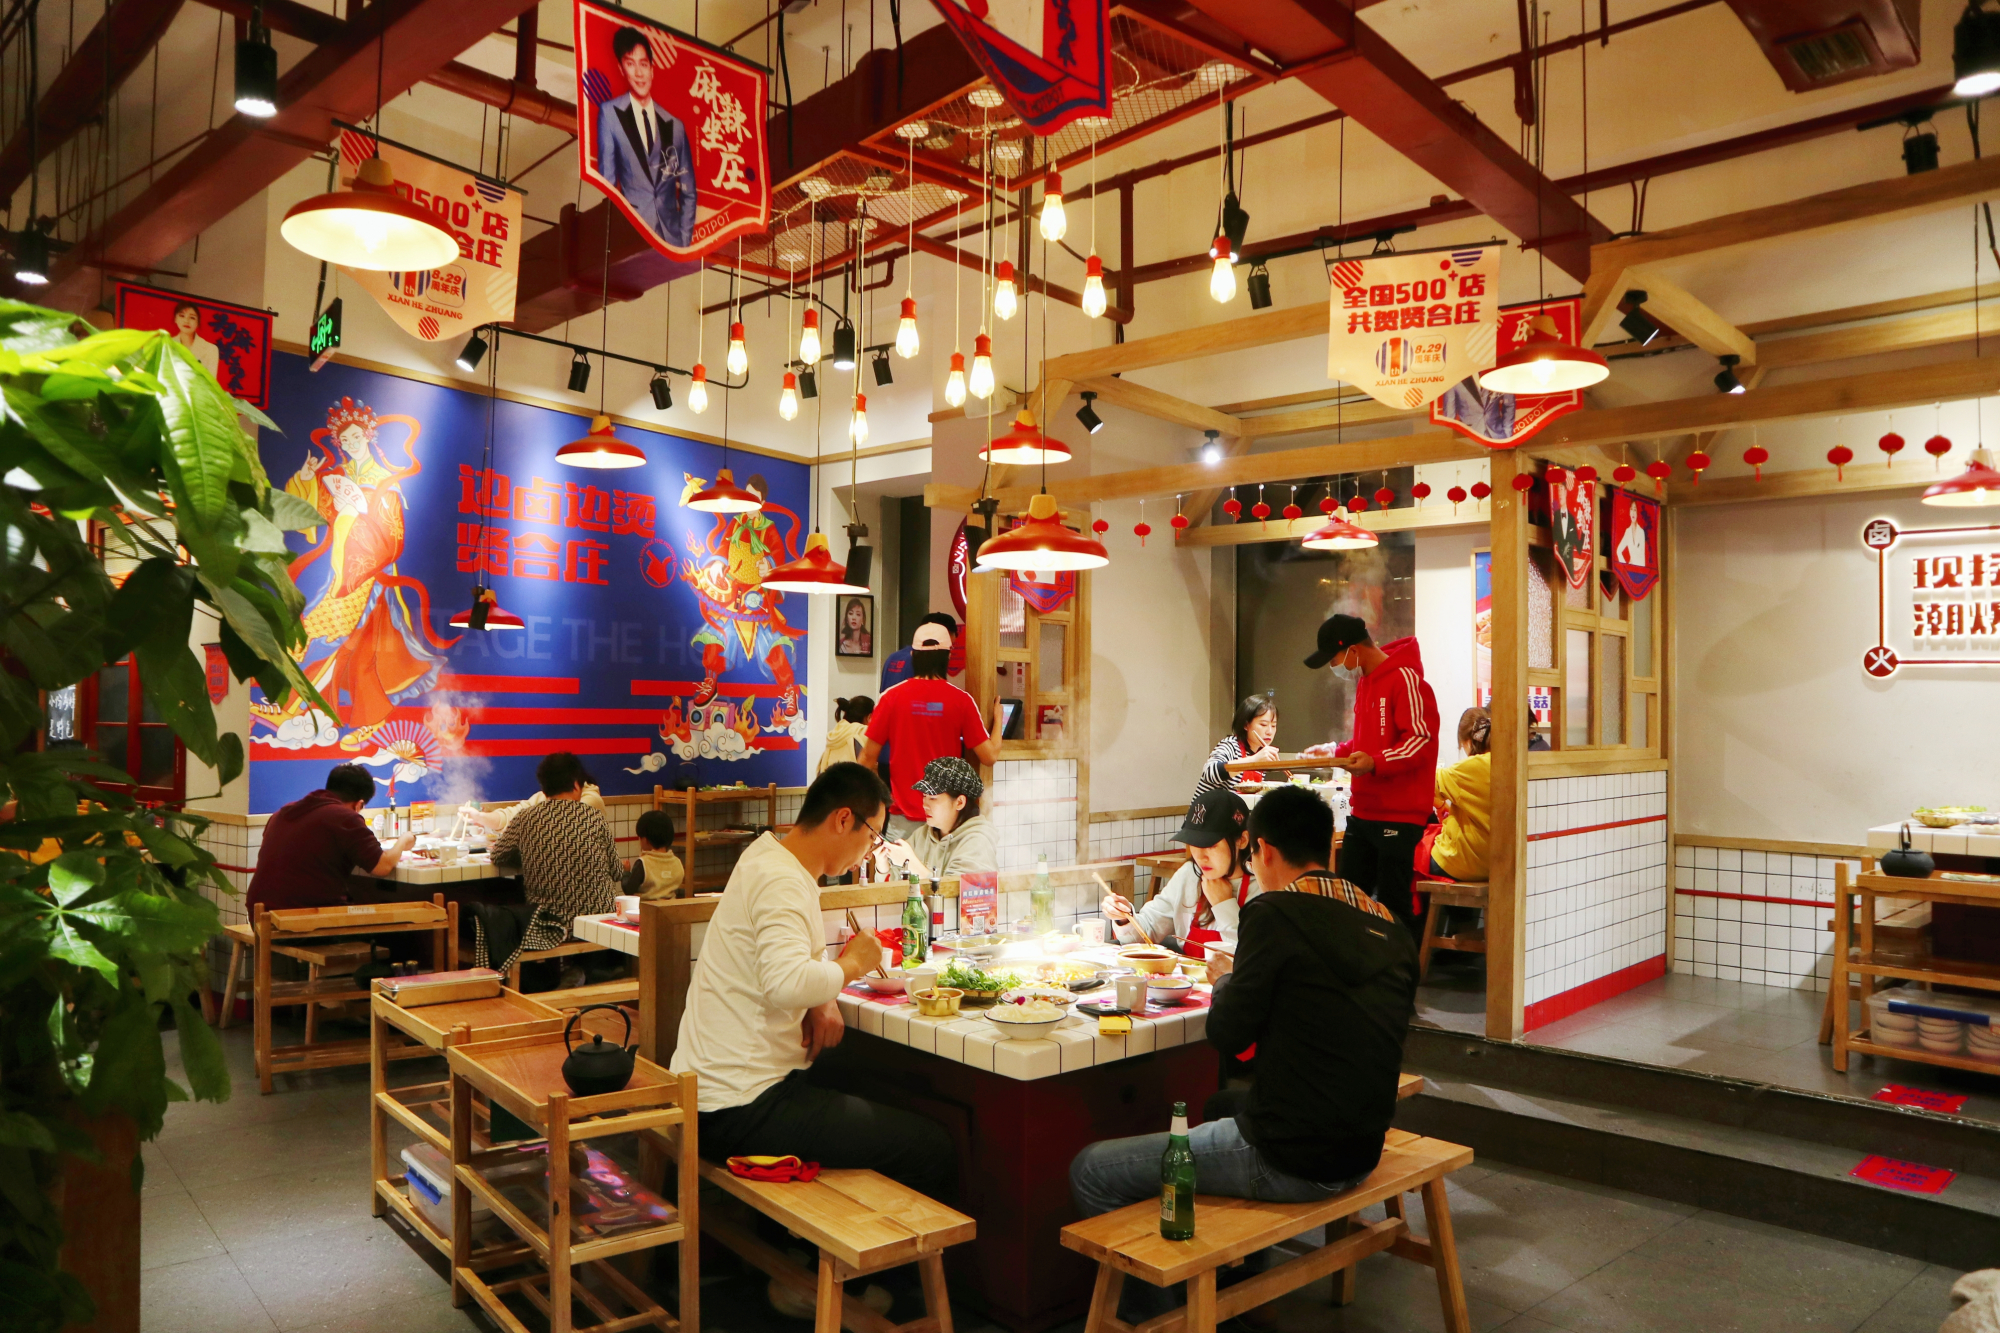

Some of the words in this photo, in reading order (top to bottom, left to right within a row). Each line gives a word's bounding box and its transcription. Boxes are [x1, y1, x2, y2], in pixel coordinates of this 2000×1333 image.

[691, 211, 731, 243] HOTPOT
[430, 281, 461, 297] 周年庆
[431, 270, 462, 285] 8.29
[387, 293, 410, 307] XIAN
[412, 299, 424, 310] HE
[425, 303, 463, 320] ZHUANG
[1347, 301, 1481, 334] 共贺贤合庄
[1414, 343, 1442, 354] 8.29
[1414, 353, 1442, 364] 周年庆
[1375, 379, 1396, 387] XIAN
[1409, 375, 1445, 384] ZHUANG
[1512, 405, 1546, 433] HOTPOT
[458, 463, 656, 539] 边卤边烫
[1868, 522, 1891, 546] 卤
[456, 521, 609, 586] 贤合庄
[1868, 648, 1895, 673] 火
